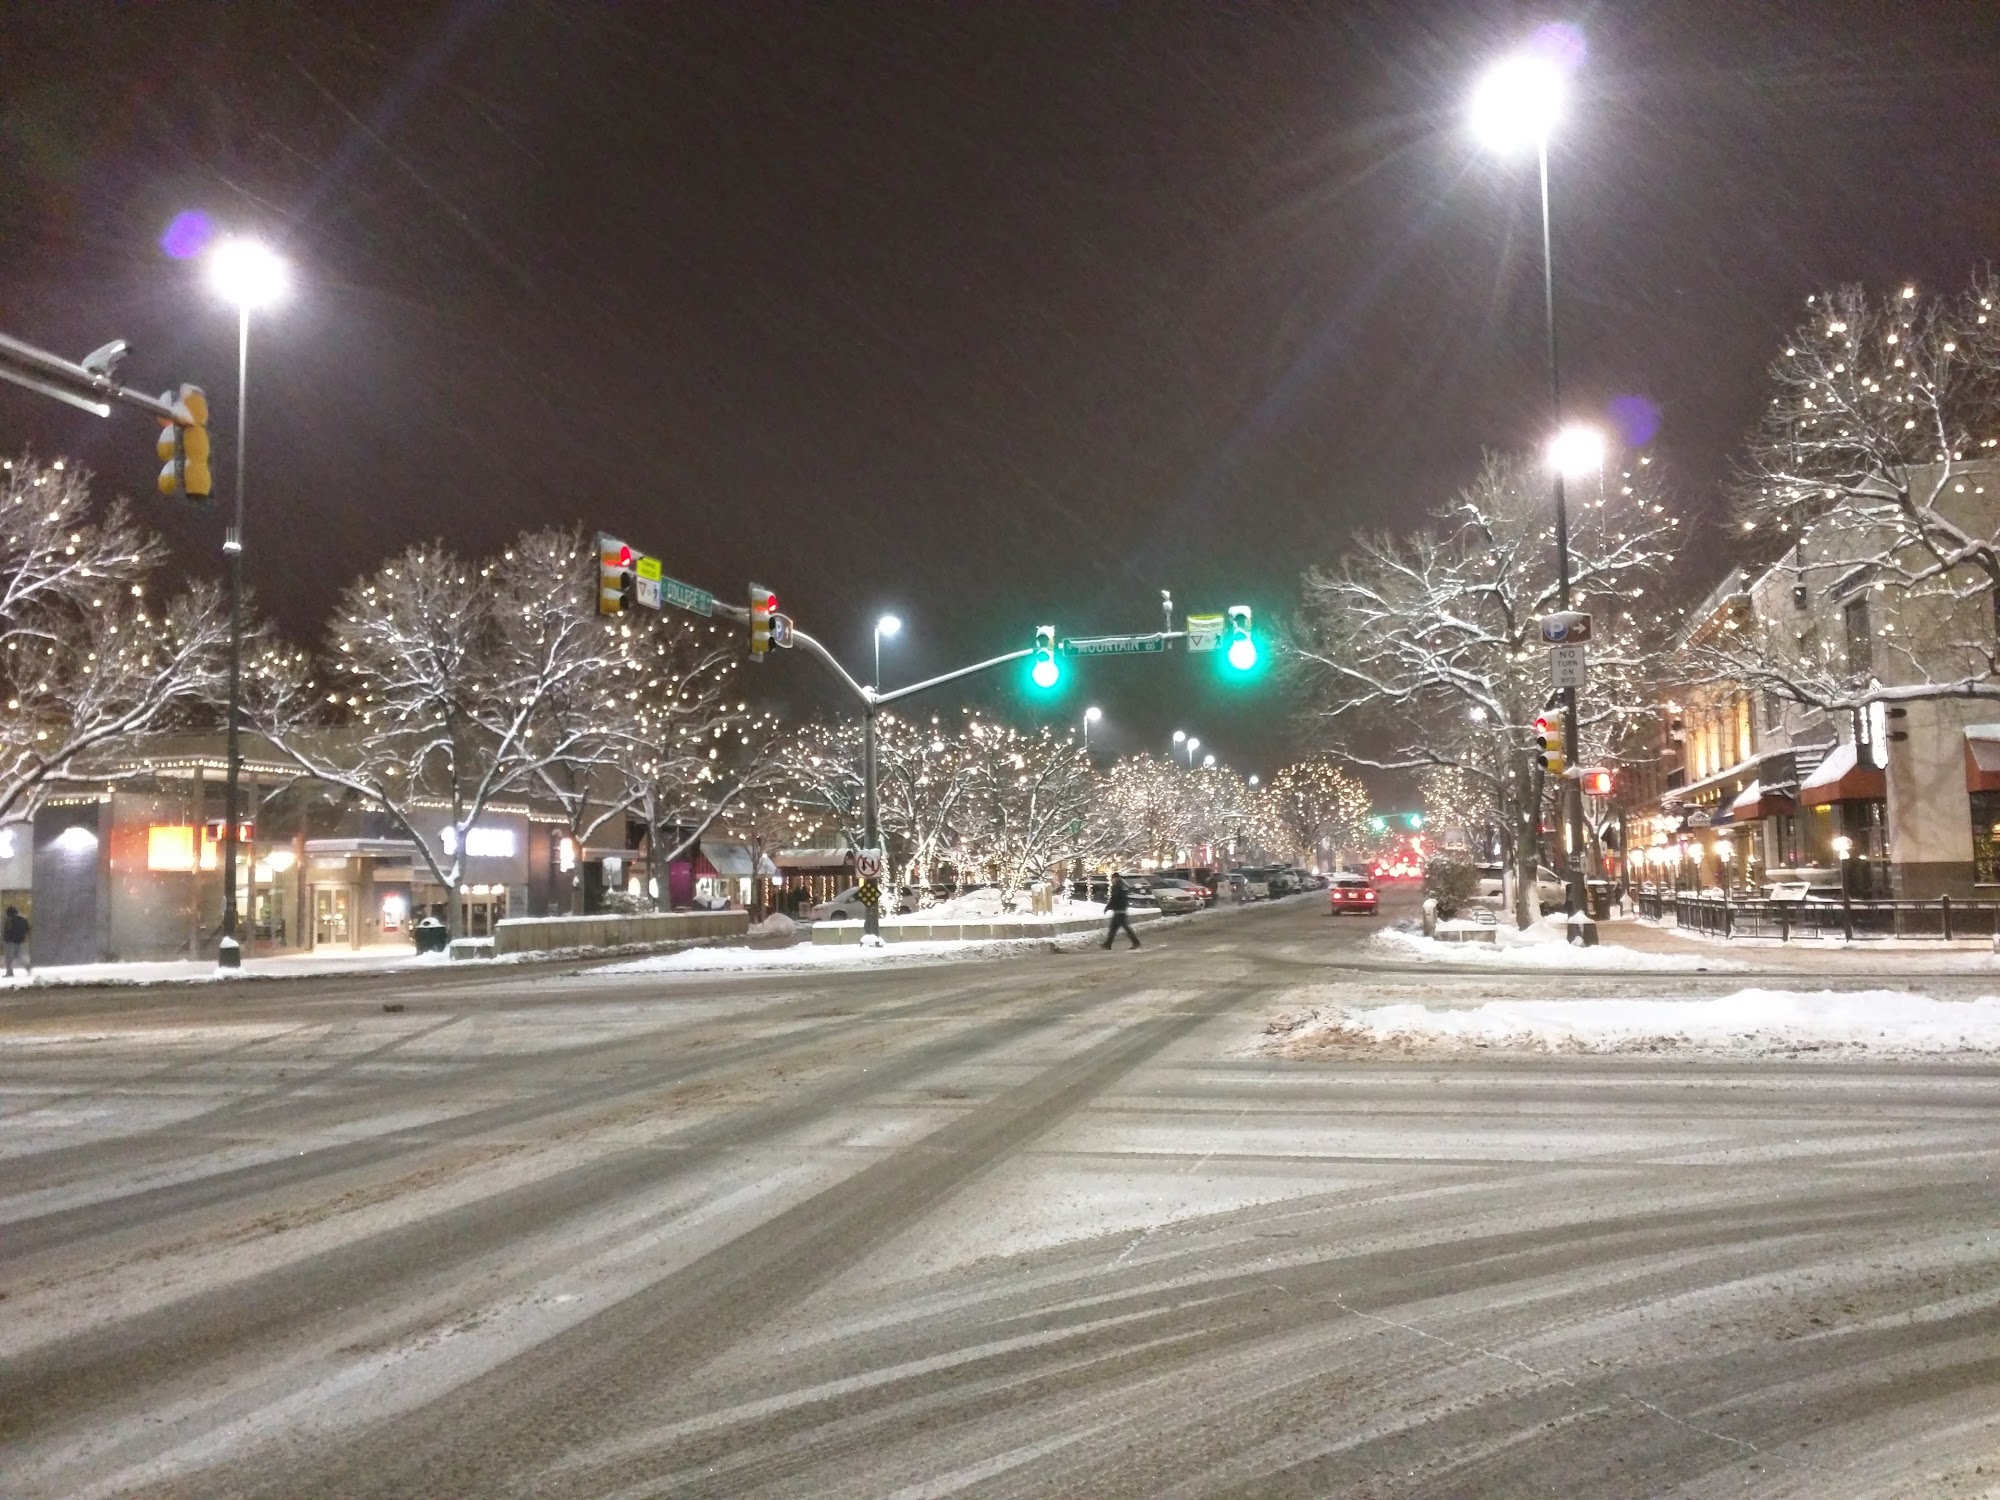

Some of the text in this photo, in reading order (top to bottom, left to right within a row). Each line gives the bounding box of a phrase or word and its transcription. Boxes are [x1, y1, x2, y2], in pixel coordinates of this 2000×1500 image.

[667, 582, 699, 608] COLLEGE
[1550, 622, 1564, 638] P
[1077, 640, 1139, 653] MOUNTAIN
[1559, 650, 1575, 659] NO
[1557, 660, 1578, 668] TURN
[1562, 668, 1574, 676] ON
